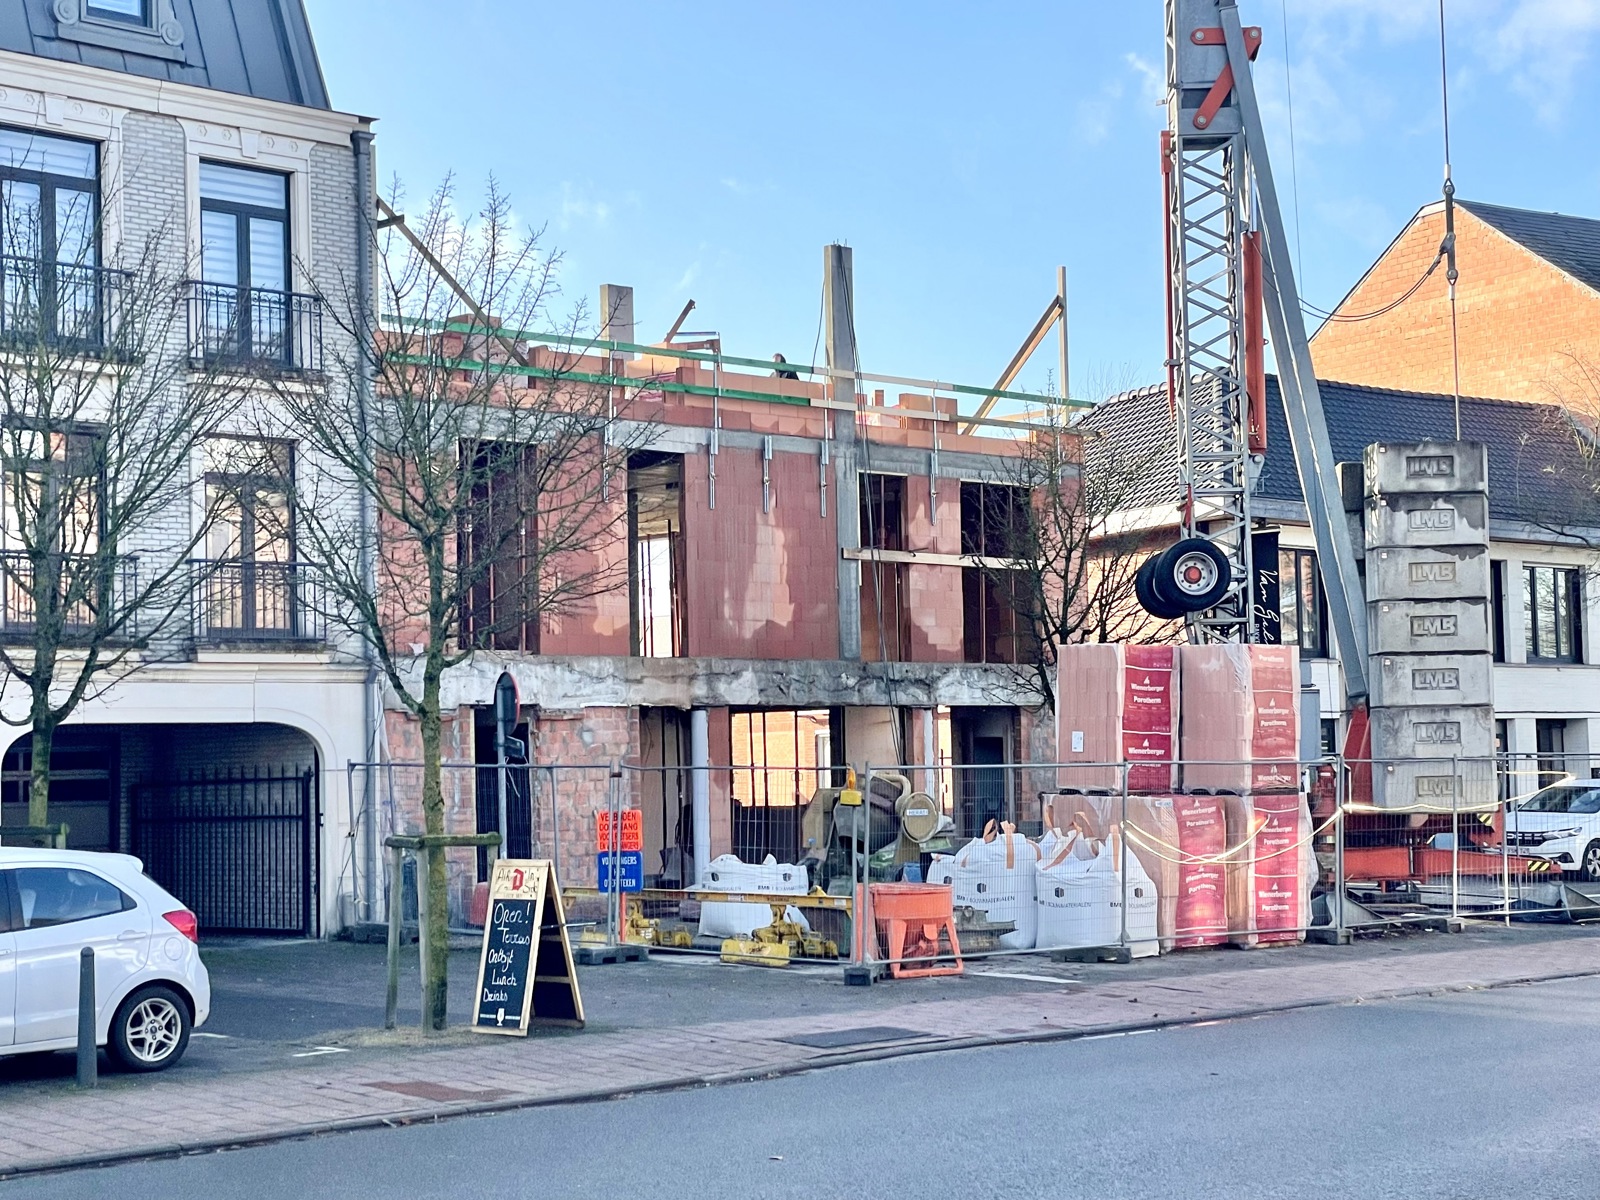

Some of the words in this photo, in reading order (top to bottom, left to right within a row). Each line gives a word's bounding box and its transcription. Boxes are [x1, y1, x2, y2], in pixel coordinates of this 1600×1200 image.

[1410, 510, 1453, 529] LMB
[1411, 563, 1454, 582] LMB
[1412, 615, 1457, 636] LMB
[1130, 683, 1165, 692] Wienerberger
[1414, 669, 1459, 690] LMB
[1133, 695, 1162, 704] Porotherm
[1416, 723, 1460, 744] LMB
[1128, 747, 1166, 756] Wienerberger
[1258, 890, 1293, 898] Wienerberger
[491, 968, 518, 987] Lunch
[483, 987, 509, 1002] Drinks
